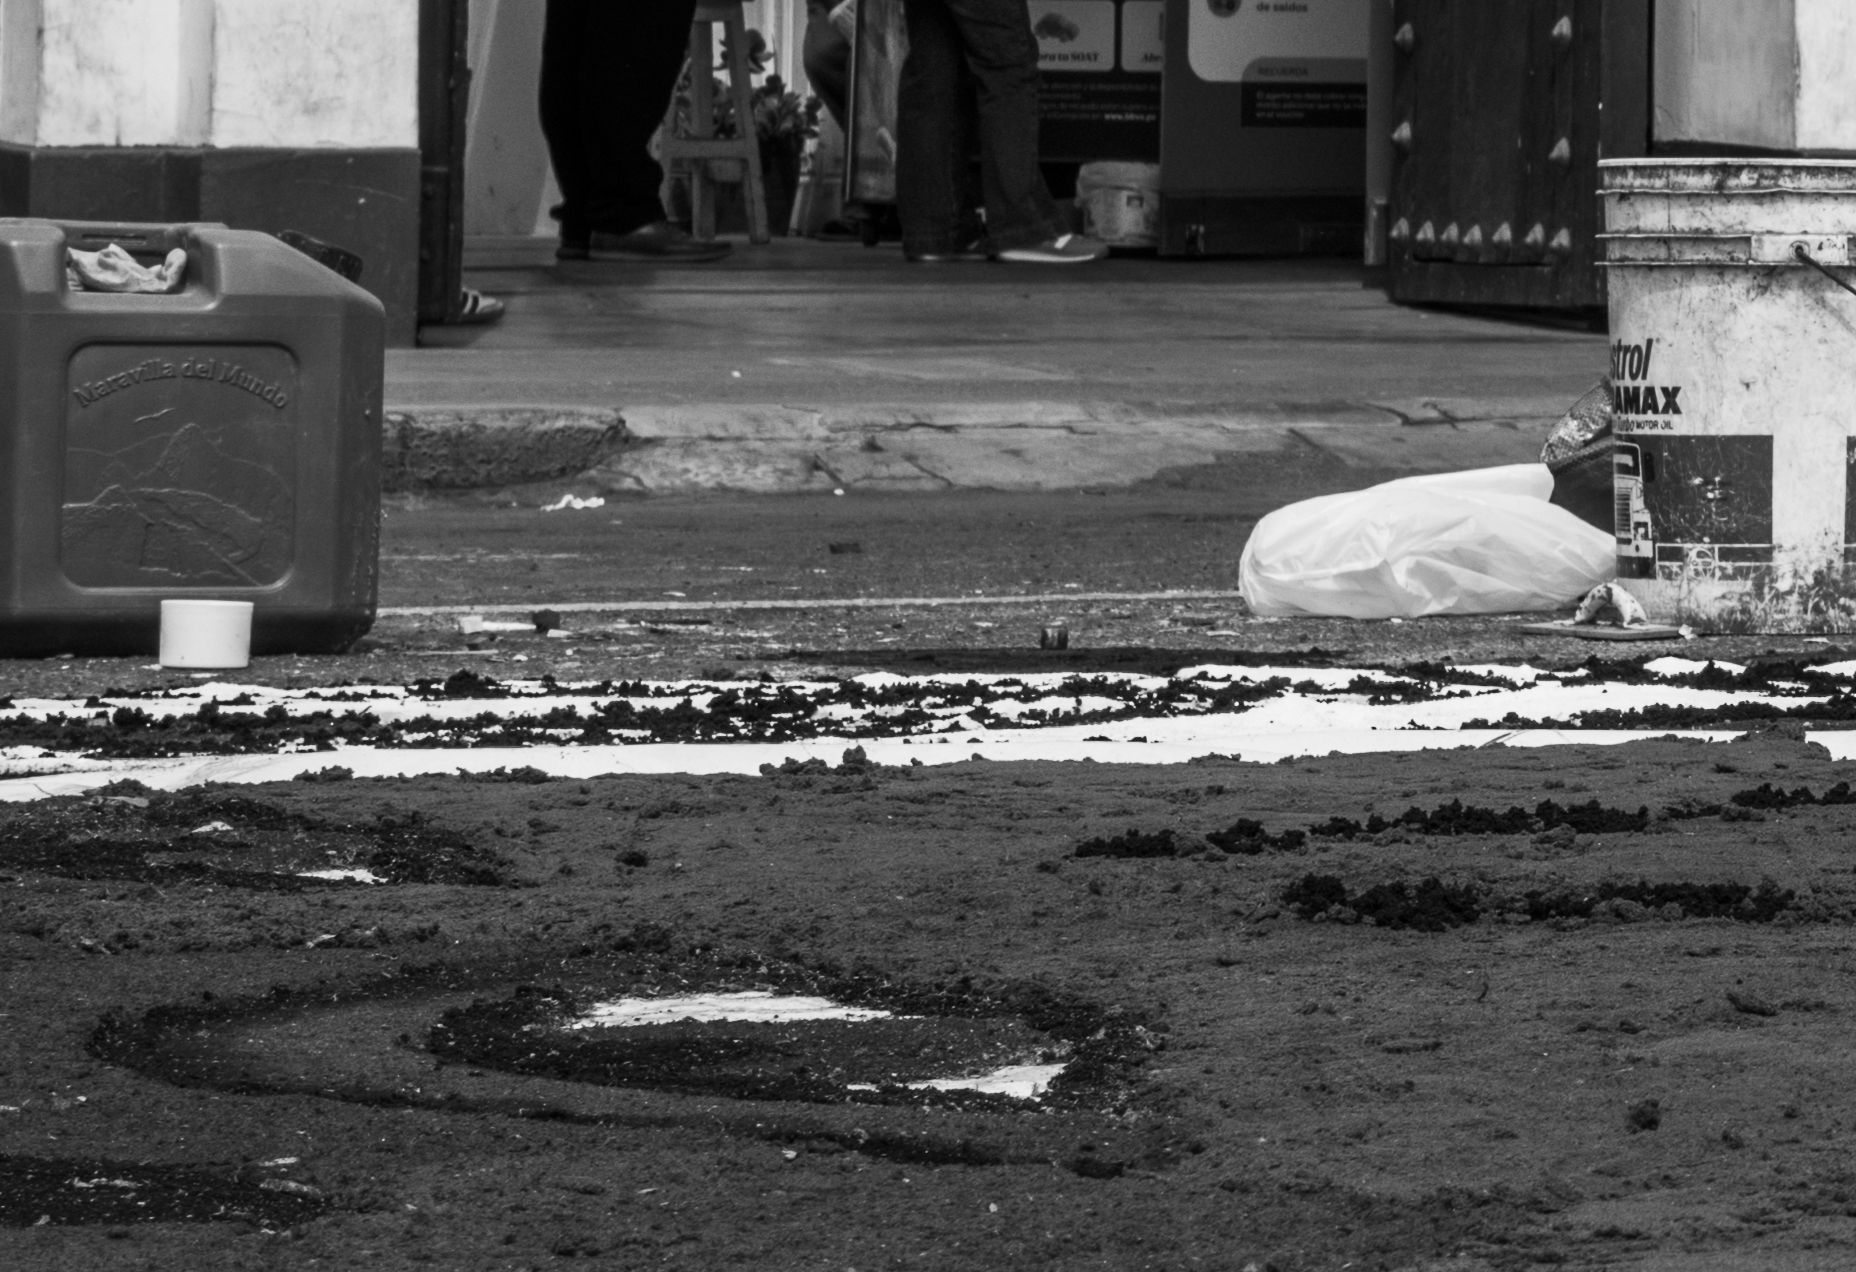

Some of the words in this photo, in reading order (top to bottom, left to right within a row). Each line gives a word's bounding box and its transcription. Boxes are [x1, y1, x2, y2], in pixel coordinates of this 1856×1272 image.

[73, 358, 177, 409] Maravilla
[181, 357, 217, 381] del
[219, 362, 289, 409] Mundo
